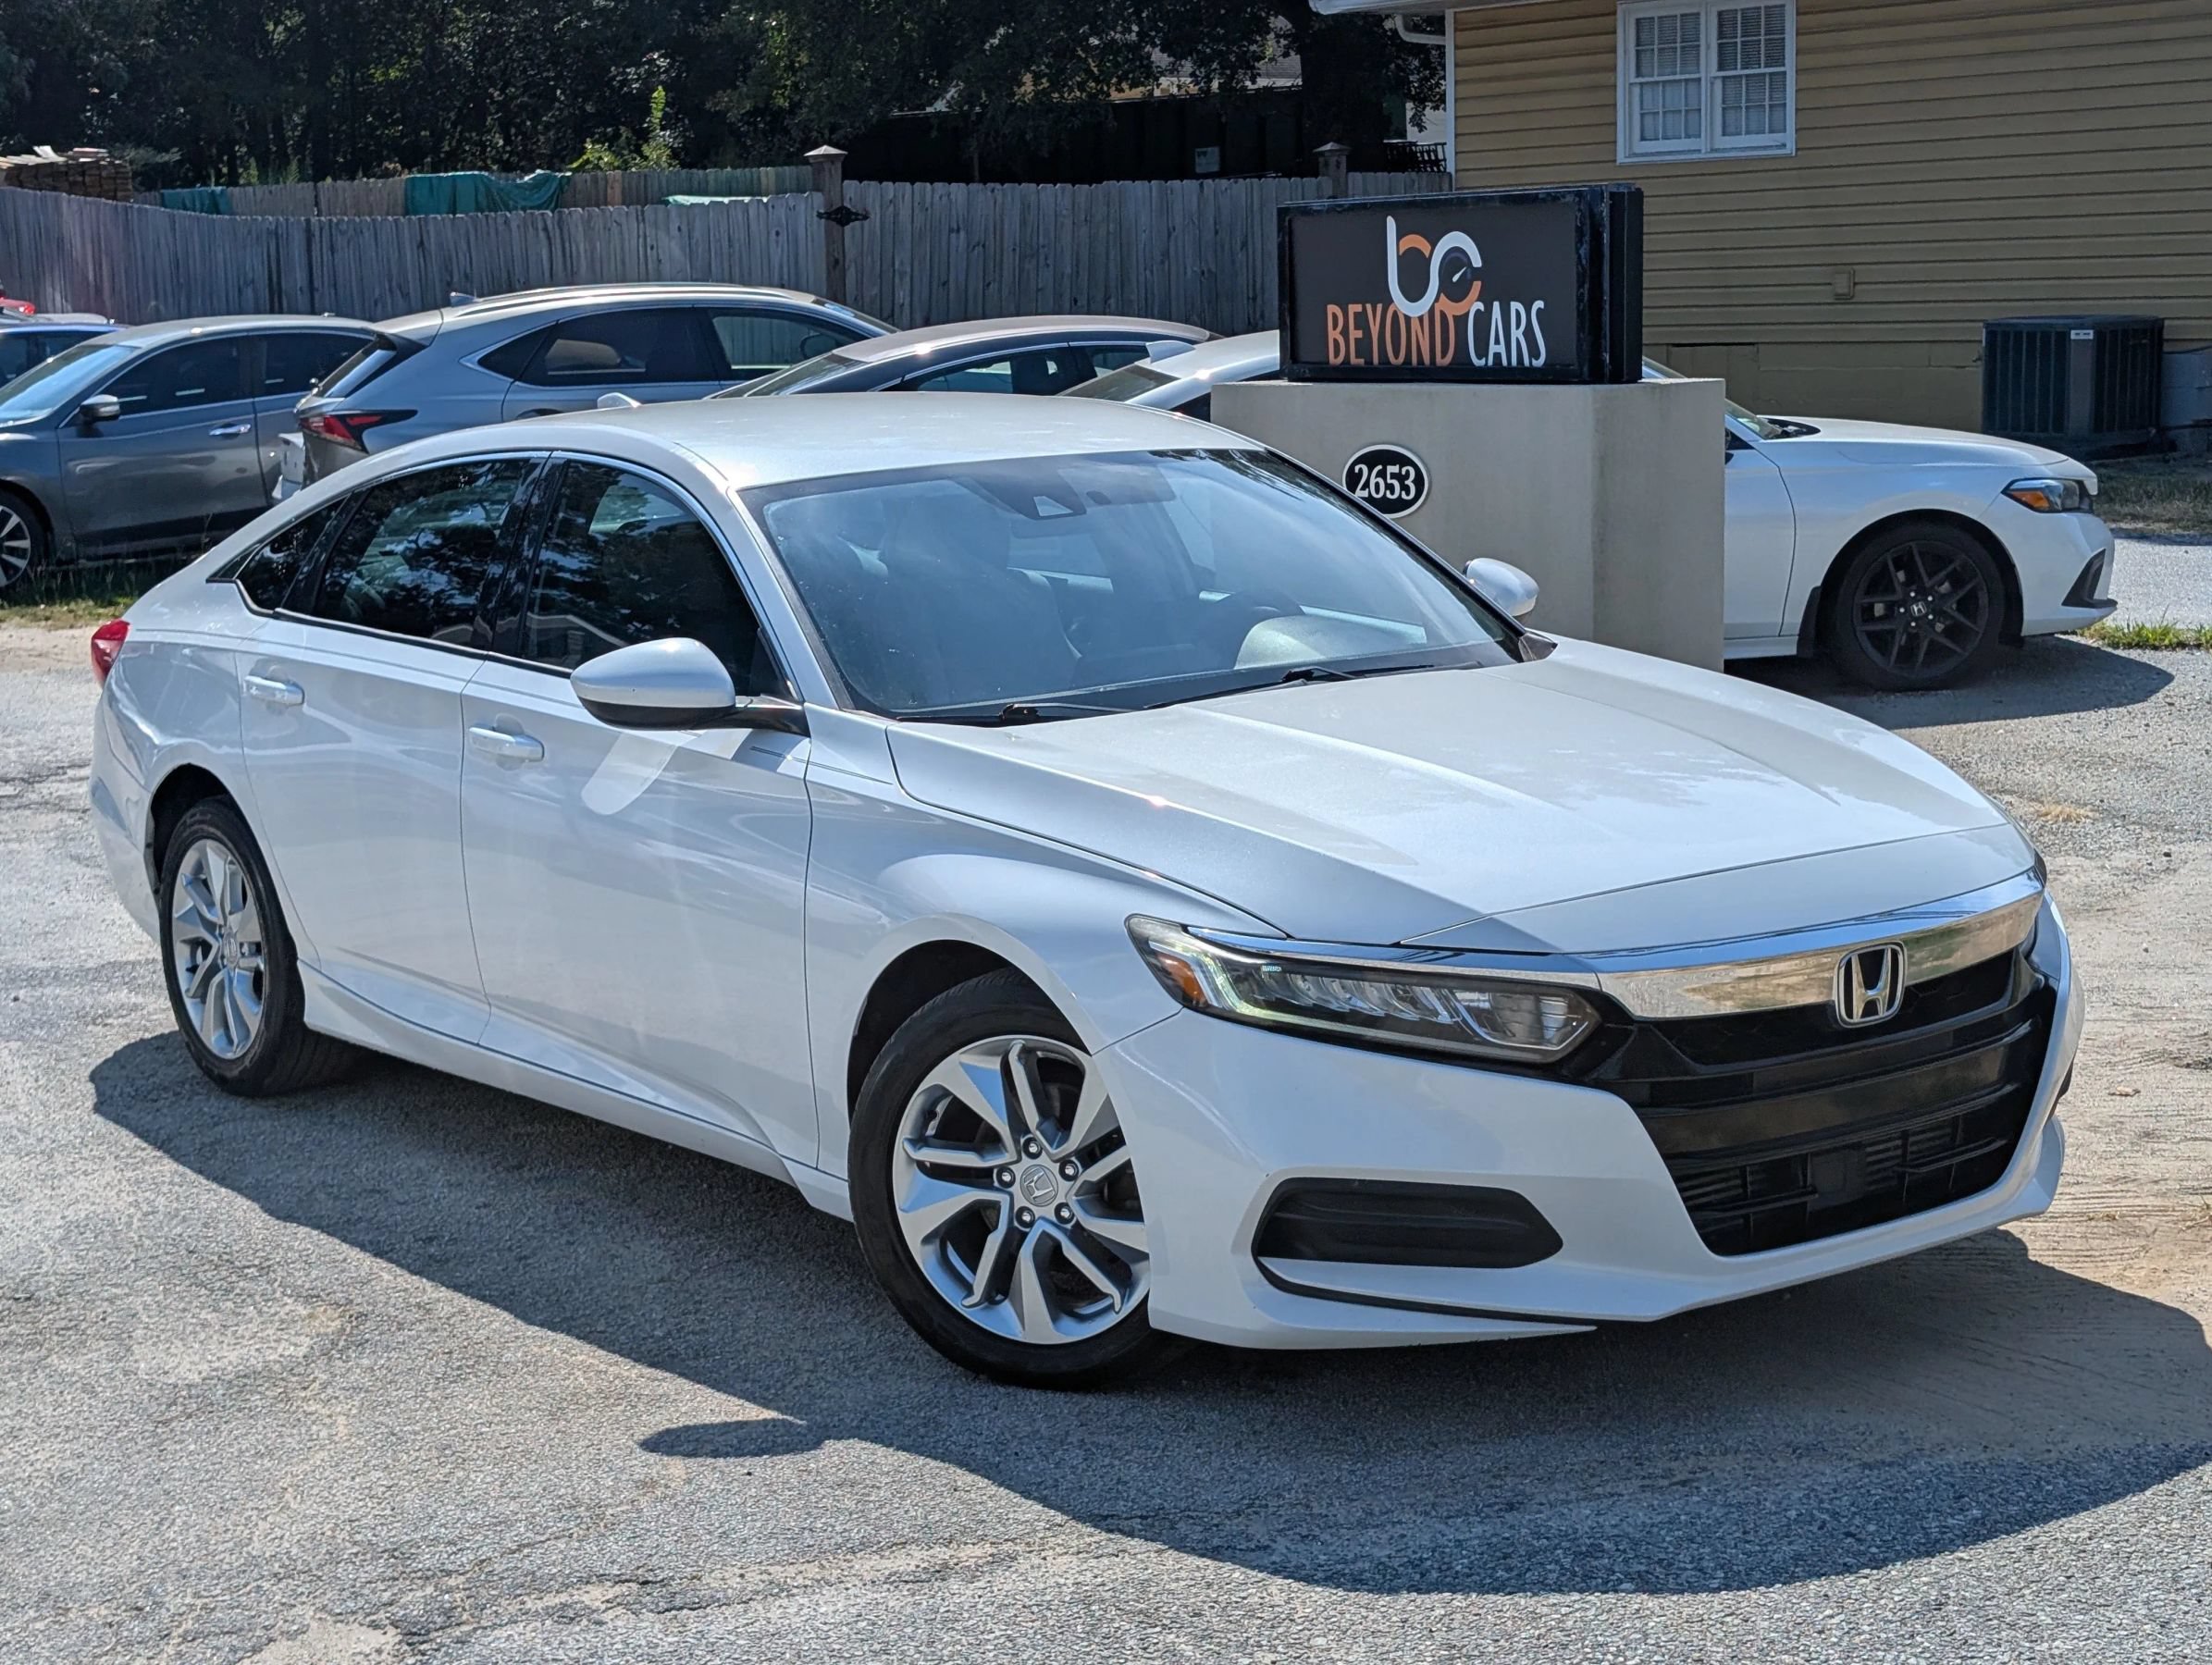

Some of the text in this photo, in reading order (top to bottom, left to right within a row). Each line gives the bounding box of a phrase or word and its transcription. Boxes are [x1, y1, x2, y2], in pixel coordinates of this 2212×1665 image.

[1327, 300, 1547, 367] BEYOND CARS
[1353, 463, 1416, 500] 2653
